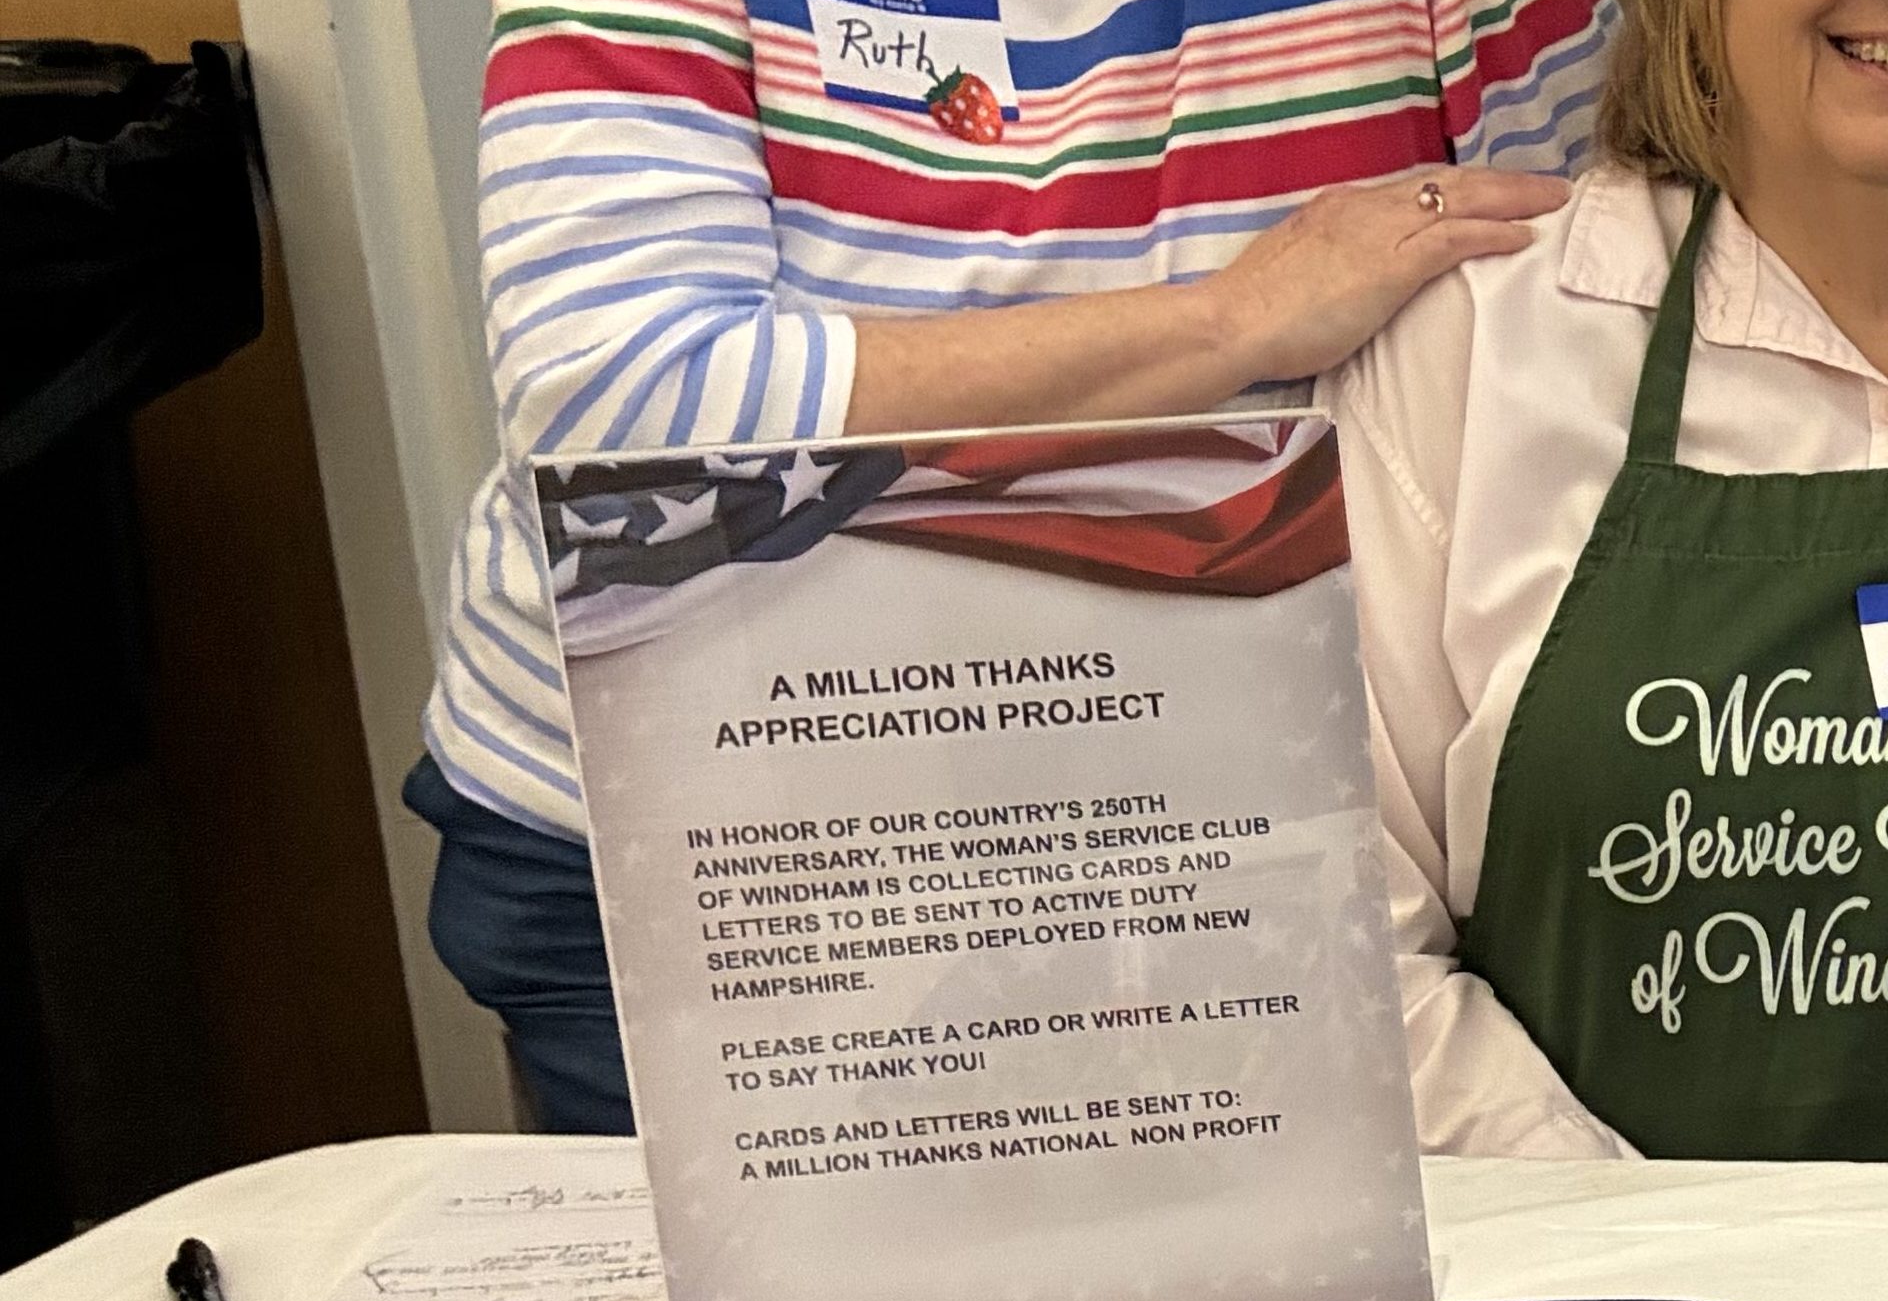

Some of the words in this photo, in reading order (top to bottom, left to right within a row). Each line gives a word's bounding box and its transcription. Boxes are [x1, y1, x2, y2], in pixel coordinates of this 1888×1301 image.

[837, 18, 935, 71] Ruth
[770, 675, 796, 701] A
[806, 663, 954, 698] MILLION
[965, 652, 1115, 687] THANKS
[716, 705, 986, 749] APPRECIATION
[998, 692, 1164, 730] PROJECT
[687, 828, 713, 849] IN
[721, 821, 819, 846] HONOR
[826, 818, 860, 838] OF
[870, 813, 927, 834] OUR
[935, 800, 1083, 830] COUNTRY'S
[1091, 794, 1166, 818] 250TH
[694, 847, 886, 879] ANNIVERSARY,
[892, 842, 944, 864] THE
[950, 832, 1077, 859] WOMAN'S
[1085, 823, 1194, 849] SERVICE
[1202, 817, 1270, 839] CLUB
[1588, 787, 1862, 905] Service
[698, 889, 732, 910] OF
[740, 879, 869, 906] WINDHAM
[877, 877, 900, 896] IS
[909, 864, 1073, 893] COLLECTING
[1082, 856, 1170, 880] CARDS
[1179, 851, 1230, 872] AND
[703, 914, 820, 941] LETTERS
[828, 910, 863, 930] TO
[872, 907, 906, 927] BE
[915, 901, 981, 923] SENT
[988, 898, 1023, 917] TO
[1032, 890, 1123, 914] ACTIVE
[1131, 883, 1196, 906] DUTY
[707, 945, 820, 971] SERVICE
[828, 933, 958, 961] MEMBERS
[967, 921, 1105, 950] DEPLOYED
[1113, 914, 1185, 937] FROM
[1193, 908, 1250, 931] NEW
[712, 972, 874, 1001] HAMPSHIRE.
[1630, 930, 1685, 1034] of
[722, 1036, 825, 1061] PLEASE
[832, 1026, 935, 1051] CREATE
[943, 1024, 961, 1042] A
[968, 1018, 1040, 1040] CARD
[1048, 1014, 1085, 1033] OR
[1091, 1005, 1172, 1029] WRITE
[1181, 1004, 1197, 1022] A
[1205, 995, 1299, 1019] LETTER
[726, 1072, 761, 1091] TO
[769, 1066, 818, 1087] SAY
[826, 1058, 916, 1082] THANK
[922, 1052, 985, 1074] YOU!
[735, 1127, 825, 1150] CARDS
[834, 1121, 888, 1143] AND
[896, 1110, 1010, 1137] LETTERS
[1016, 1104, 1079, 1126] WILL
[1087, 1100, 1120, 1120] BE
[1128, 1094, 1192, 1116] SENT
[1199, 1090, 1241, 1109] TO:
[741, 1163, 758, 1181] A
[765, 1152, 869, 1178] MILLION
[877, 1142, 982, 1168] THANKS
[990, 1131, 1118, 1158] NATIONAL
[1131, 1123, 1185, 1145] NON
[1193, 1114, 1281, 1140] PROFIT
